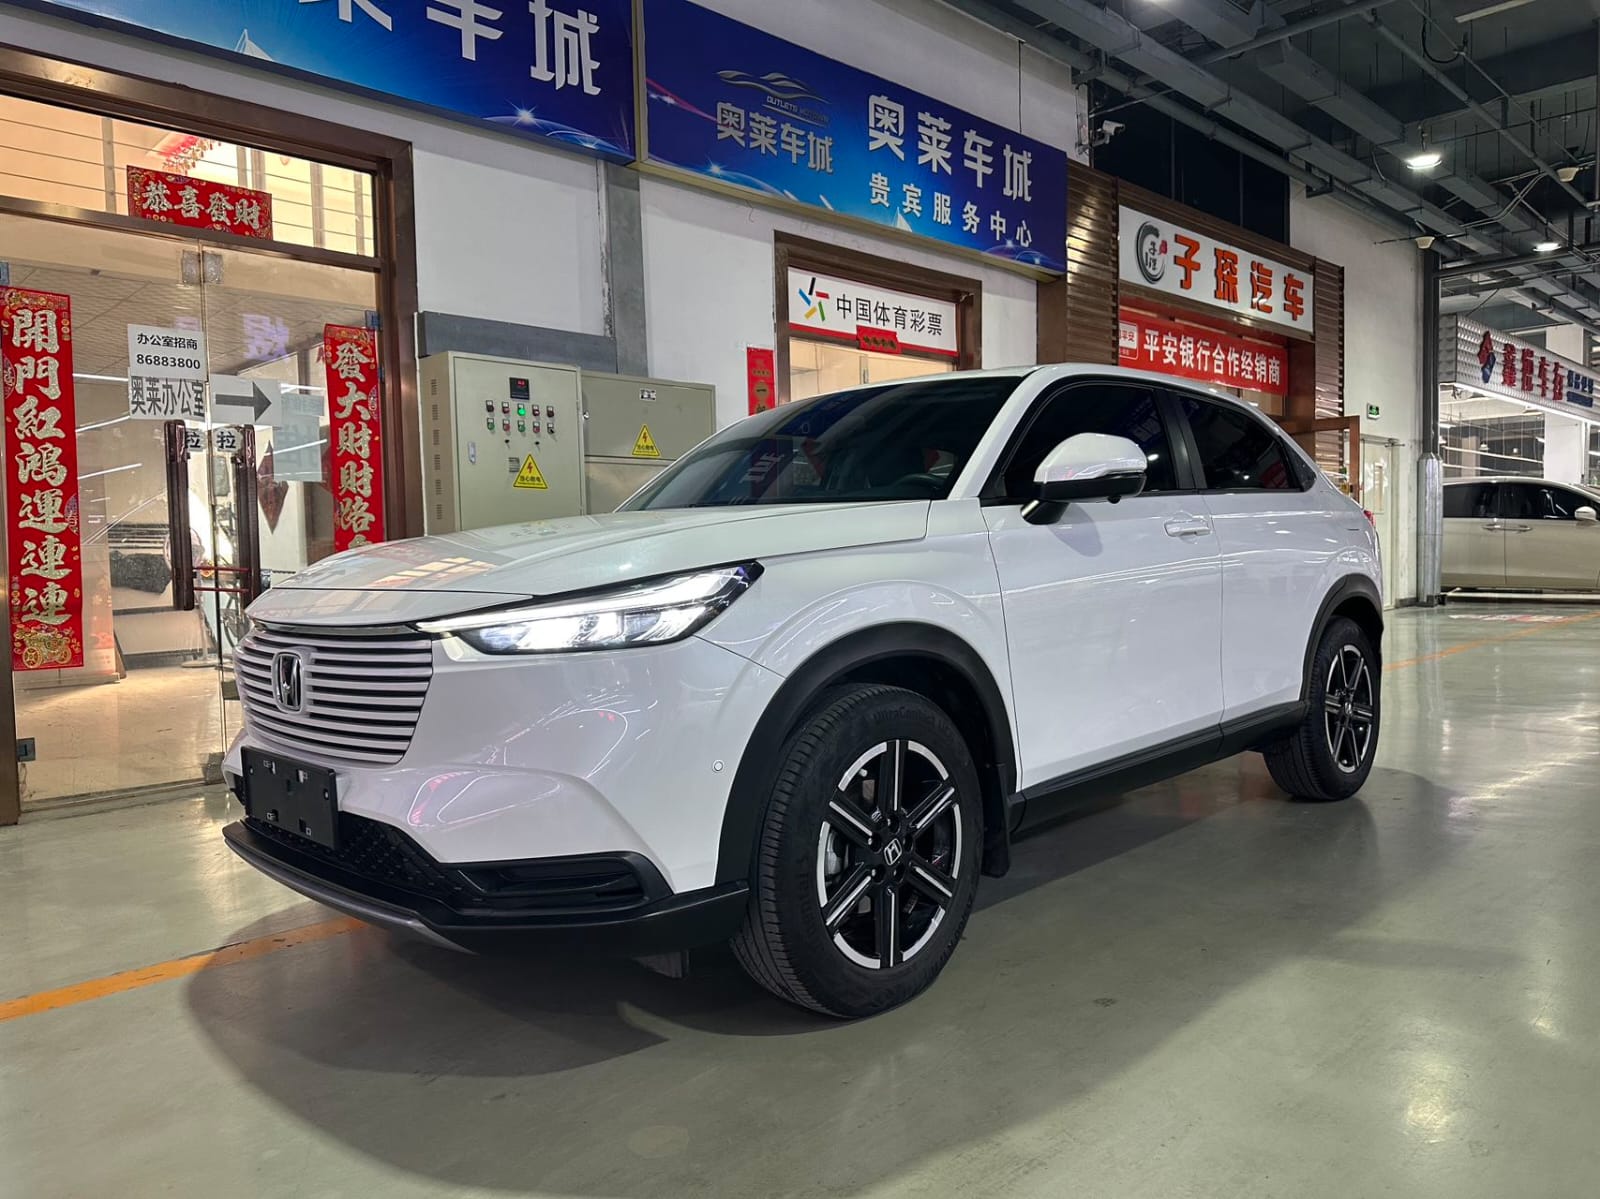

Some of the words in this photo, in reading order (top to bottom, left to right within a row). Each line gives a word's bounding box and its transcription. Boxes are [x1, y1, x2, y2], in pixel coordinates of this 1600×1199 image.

[716, 101, 834, 174] 奥莱车城
[868, 94, 1032, 202] 奥莱车城
[142, 180, 261, 229] 恭喜發財
[869, 172, 1032, 248] 贵宾服务中心
[1174, 233, 1304, 321] 子琛汽车
[836, 293, 942, 336] 中国体育彩票
[136, 354, 201, 369] 86883800
[137, 333, 198, 350] 办公室招商
[1144, 328, 1280, 386] 平安银行合作经销商
[131, 376, 205, 417] 奥莱办公室
[186, 432, 201, 448] 拉
[217, 431, 237, 449] 拉
[11, 309, 73, 626] 開門紅鴻運連連
